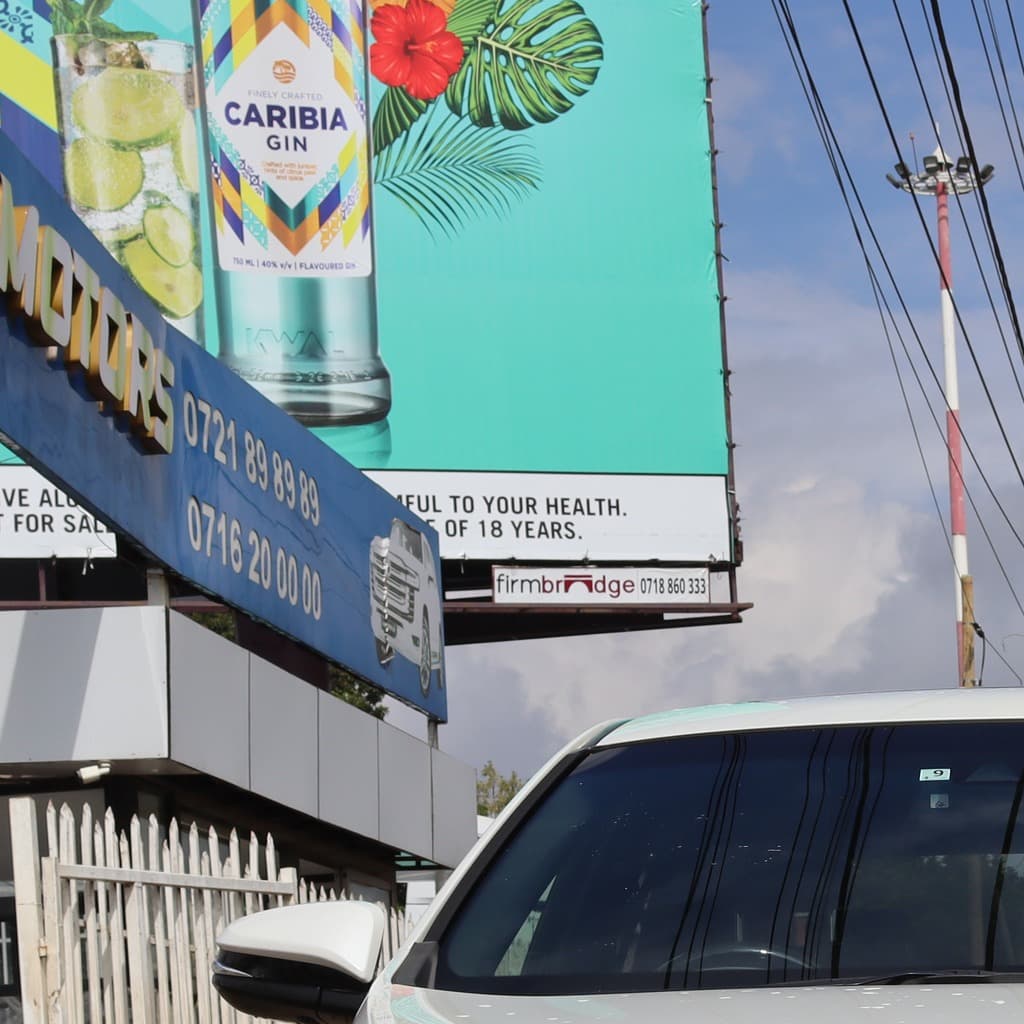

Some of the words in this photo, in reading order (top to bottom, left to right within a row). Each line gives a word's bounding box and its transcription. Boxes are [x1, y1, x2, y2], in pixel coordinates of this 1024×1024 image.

[224, 101, 348, 131] CARIBIA
[266, 134, 308, 153] GIN
[299, 262, 344, 270] FLAVOURED
[0, 172, 175, 455] MOTORS
[183, 390, 238, 472] 0721
[244, 430, 268, 491] 89
[272, 450, 296, 511] 89
[299, 468, 320, 527] 89
[396, 494, 442, 513] FUL
[449, 495, 475, 513] TO
[482, 495, 538, 515] YOUR
[545, 497, 627, 517] HEALTH.
[14, 514, 54, 533] FOR
[445, 519, 468, 537] OF
[479, 520, 503, 538] 18
[510, 520, 583, 540] YEARS.
[187, 495, 243, 574] 0716
[248, 529, 272, 591] 20
[276, 546, 298, 606] 00
[302, 563, 322, 621] 00
[640, 577, 665, 595] 0718
[667, 578, 686, 595] 860
[688, 577, 706, 595] 333
